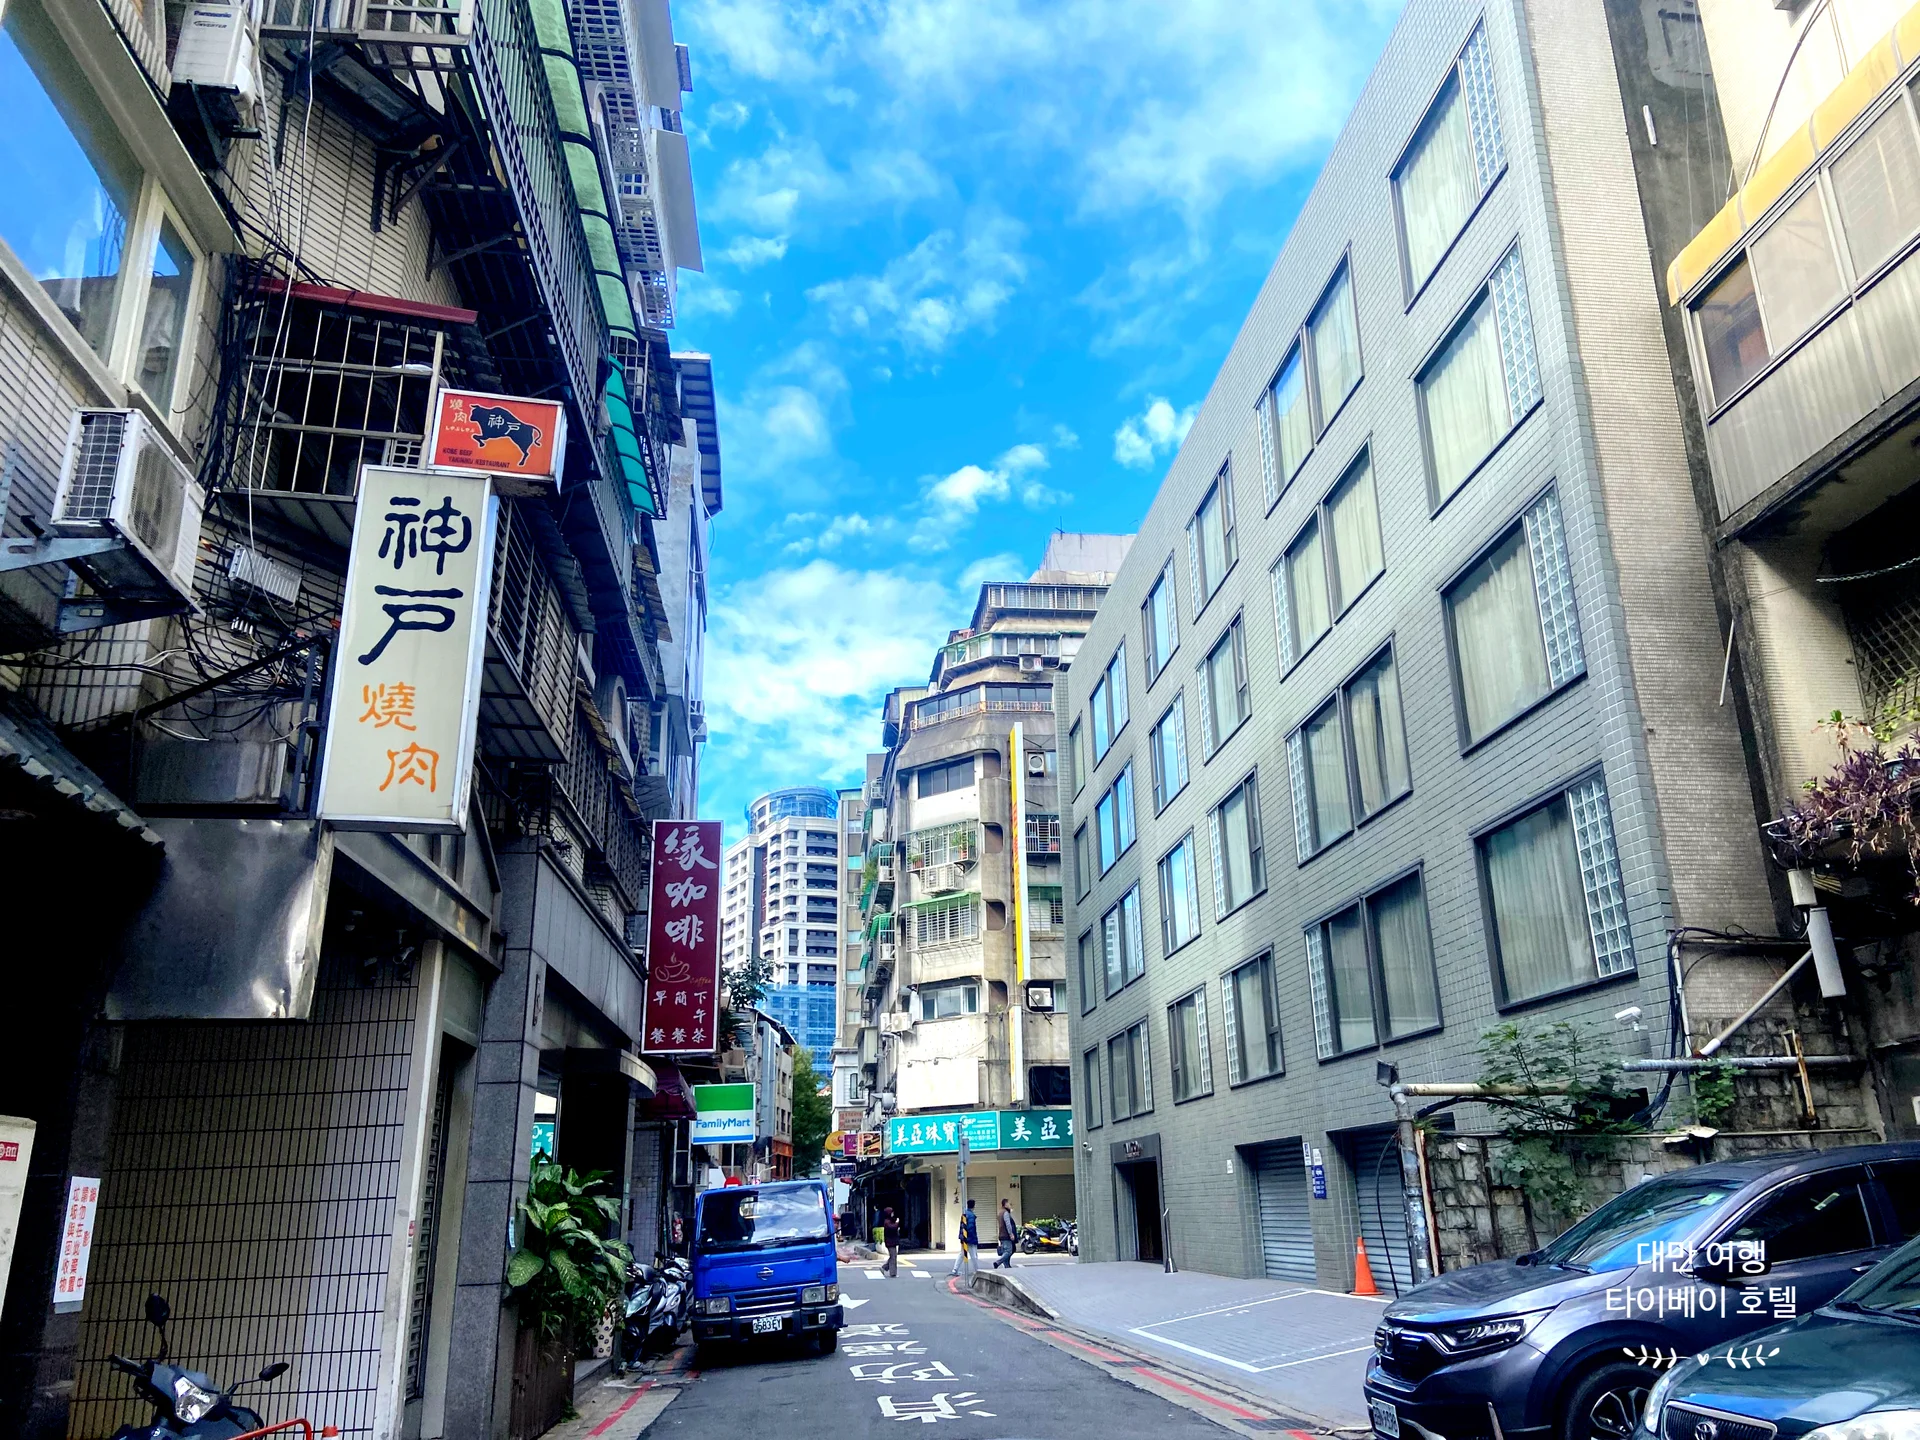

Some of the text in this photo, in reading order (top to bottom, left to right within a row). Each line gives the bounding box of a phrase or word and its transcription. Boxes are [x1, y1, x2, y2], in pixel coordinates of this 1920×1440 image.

[359, 681, 439, 792] 燒肉
[695, 1117, 751, 1130] FamilyMart
[893, 1120, 957, 1147] 美亞珠寶
[1010, 1115, 1073, 1142] 美亞
